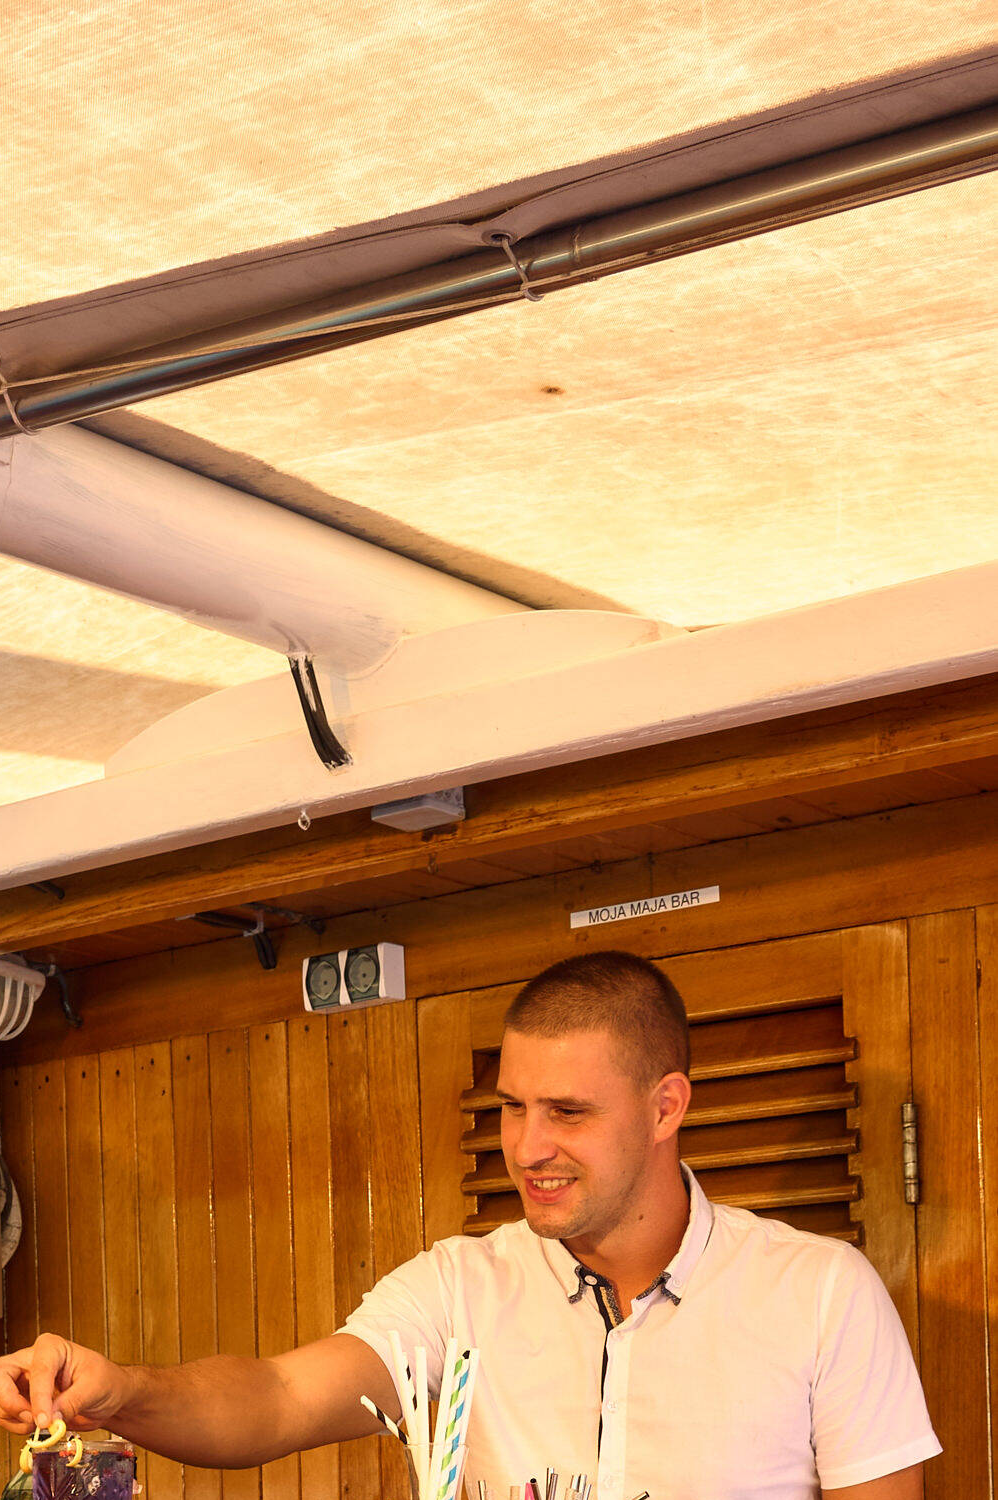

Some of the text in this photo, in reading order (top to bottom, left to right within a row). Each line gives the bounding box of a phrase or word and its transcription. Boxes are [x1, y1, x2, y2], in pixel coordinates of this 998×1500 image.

[588, 891, 700, 923] MOJA MAJA BAR
